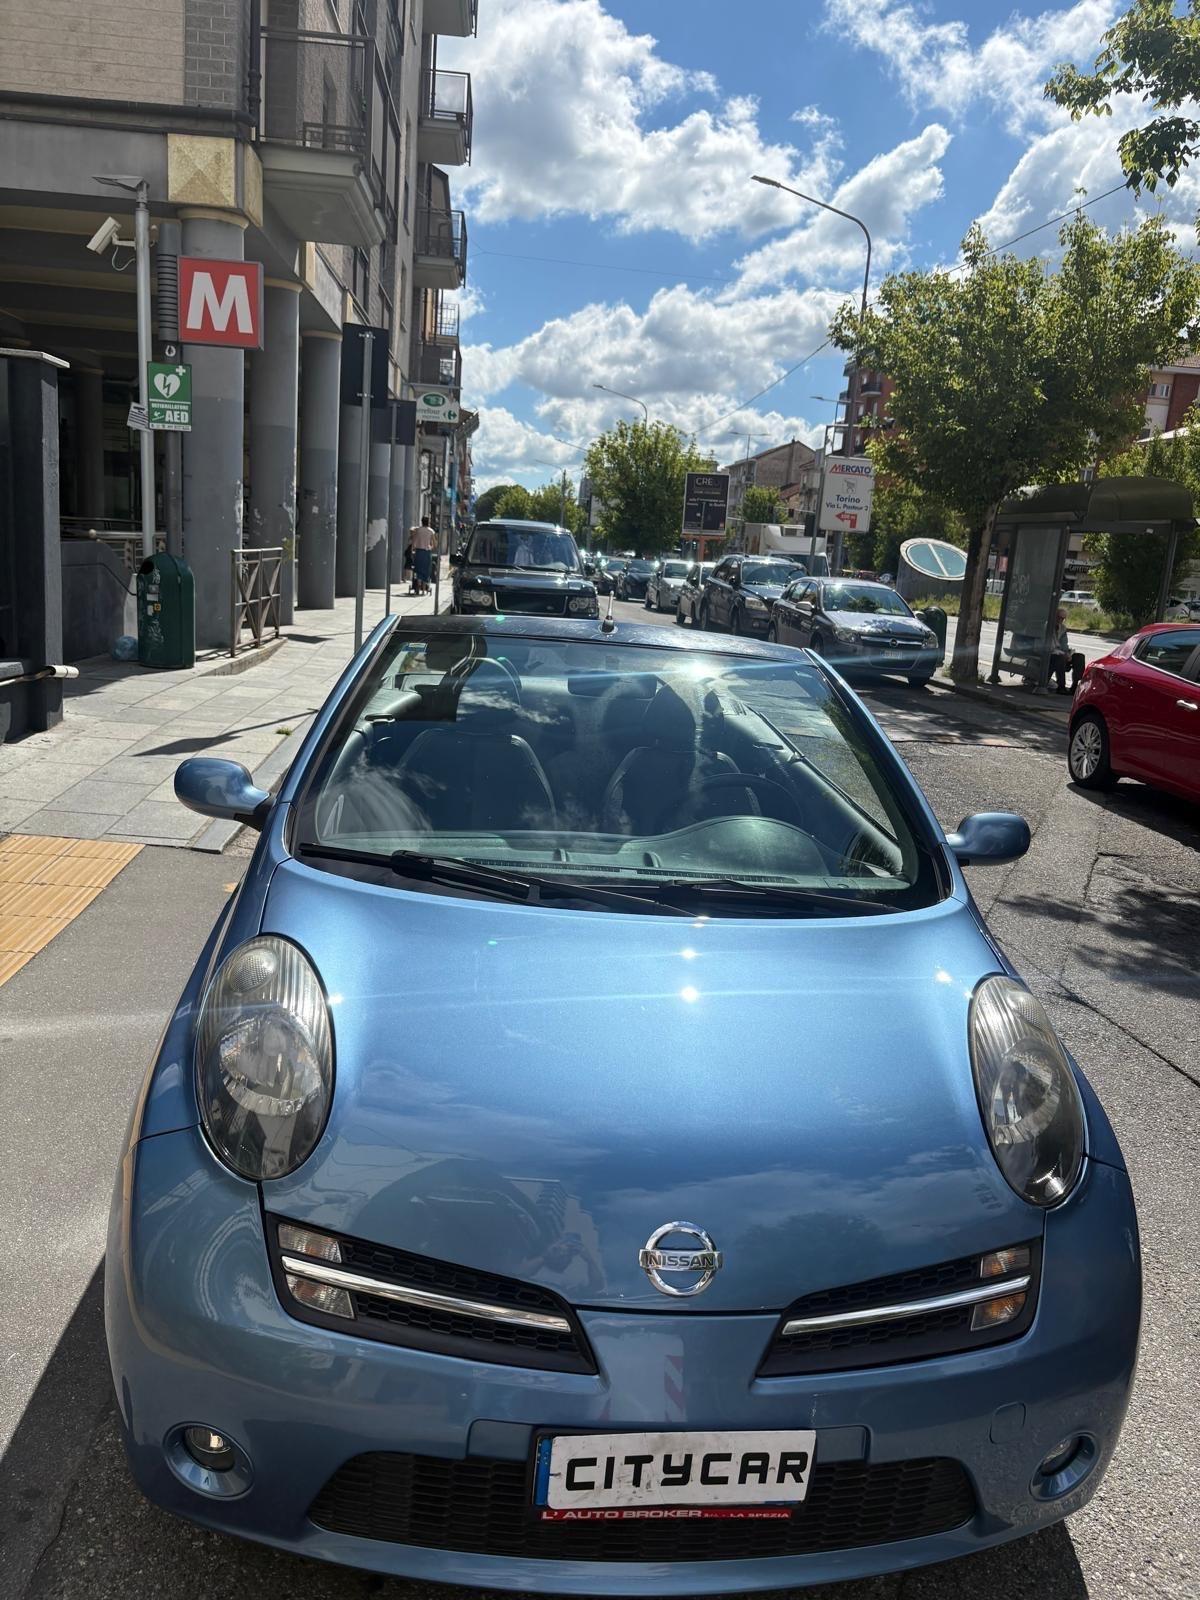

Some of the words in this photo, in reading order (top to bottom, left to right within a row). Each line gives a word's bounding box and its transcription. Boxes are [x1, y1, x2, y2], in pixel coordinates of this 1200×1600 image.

[186, 271, 253, 334] M
[165, 410, 189, 424] AED
[835, 494, 861, 504] Torino
[649, 1254, 714, 1267] NISSAN
[565, 1452, 808, 1491] CITYCAR
[562, 1510, 620, 1519] AUTO
[622, 1509, 702, 1518] BROKER
